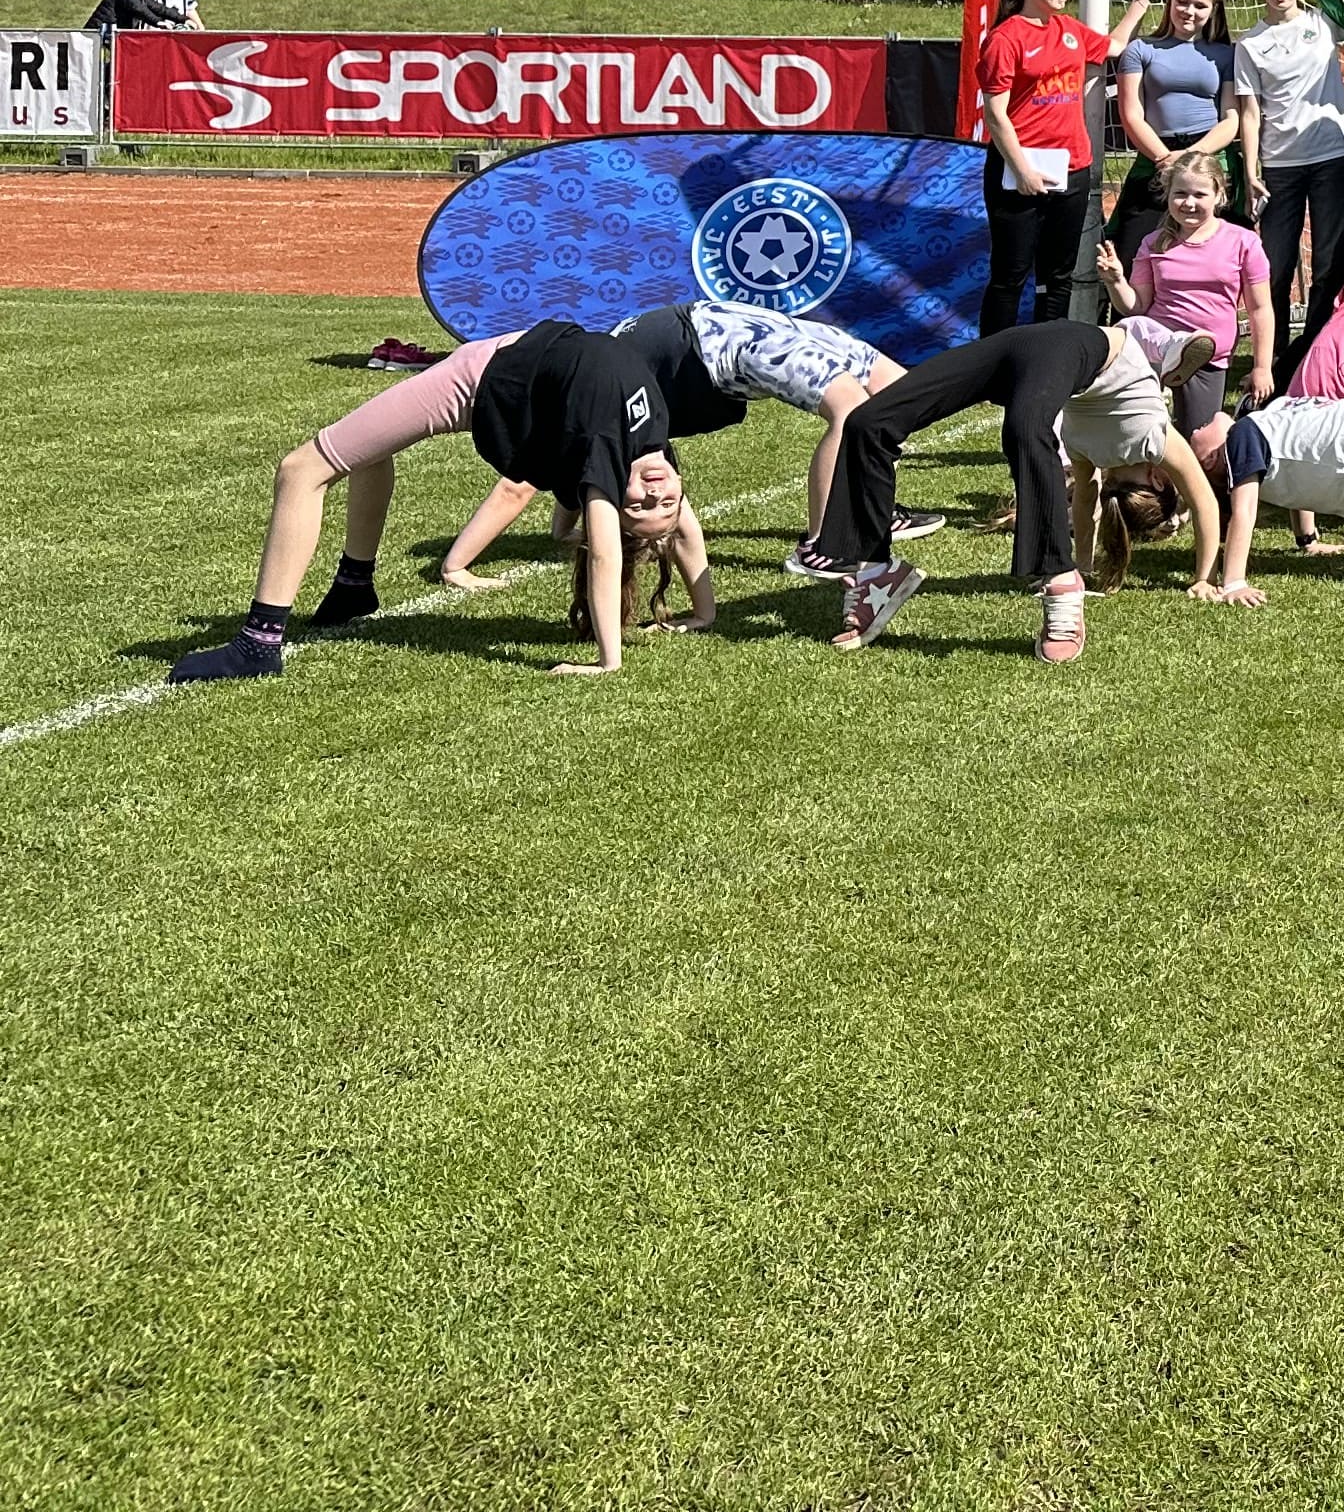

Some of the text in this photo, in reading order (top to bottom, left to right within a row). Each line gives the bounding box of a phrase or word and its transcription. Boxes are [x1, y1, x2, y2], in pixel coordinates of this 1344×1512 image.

[326, 49, 833, 126] SPORTLAND
[733, 187, 819, 214] EESTI
[702, 228, 815, 312] JALGPALLI
[813, 228, 842, 282] LIIT
